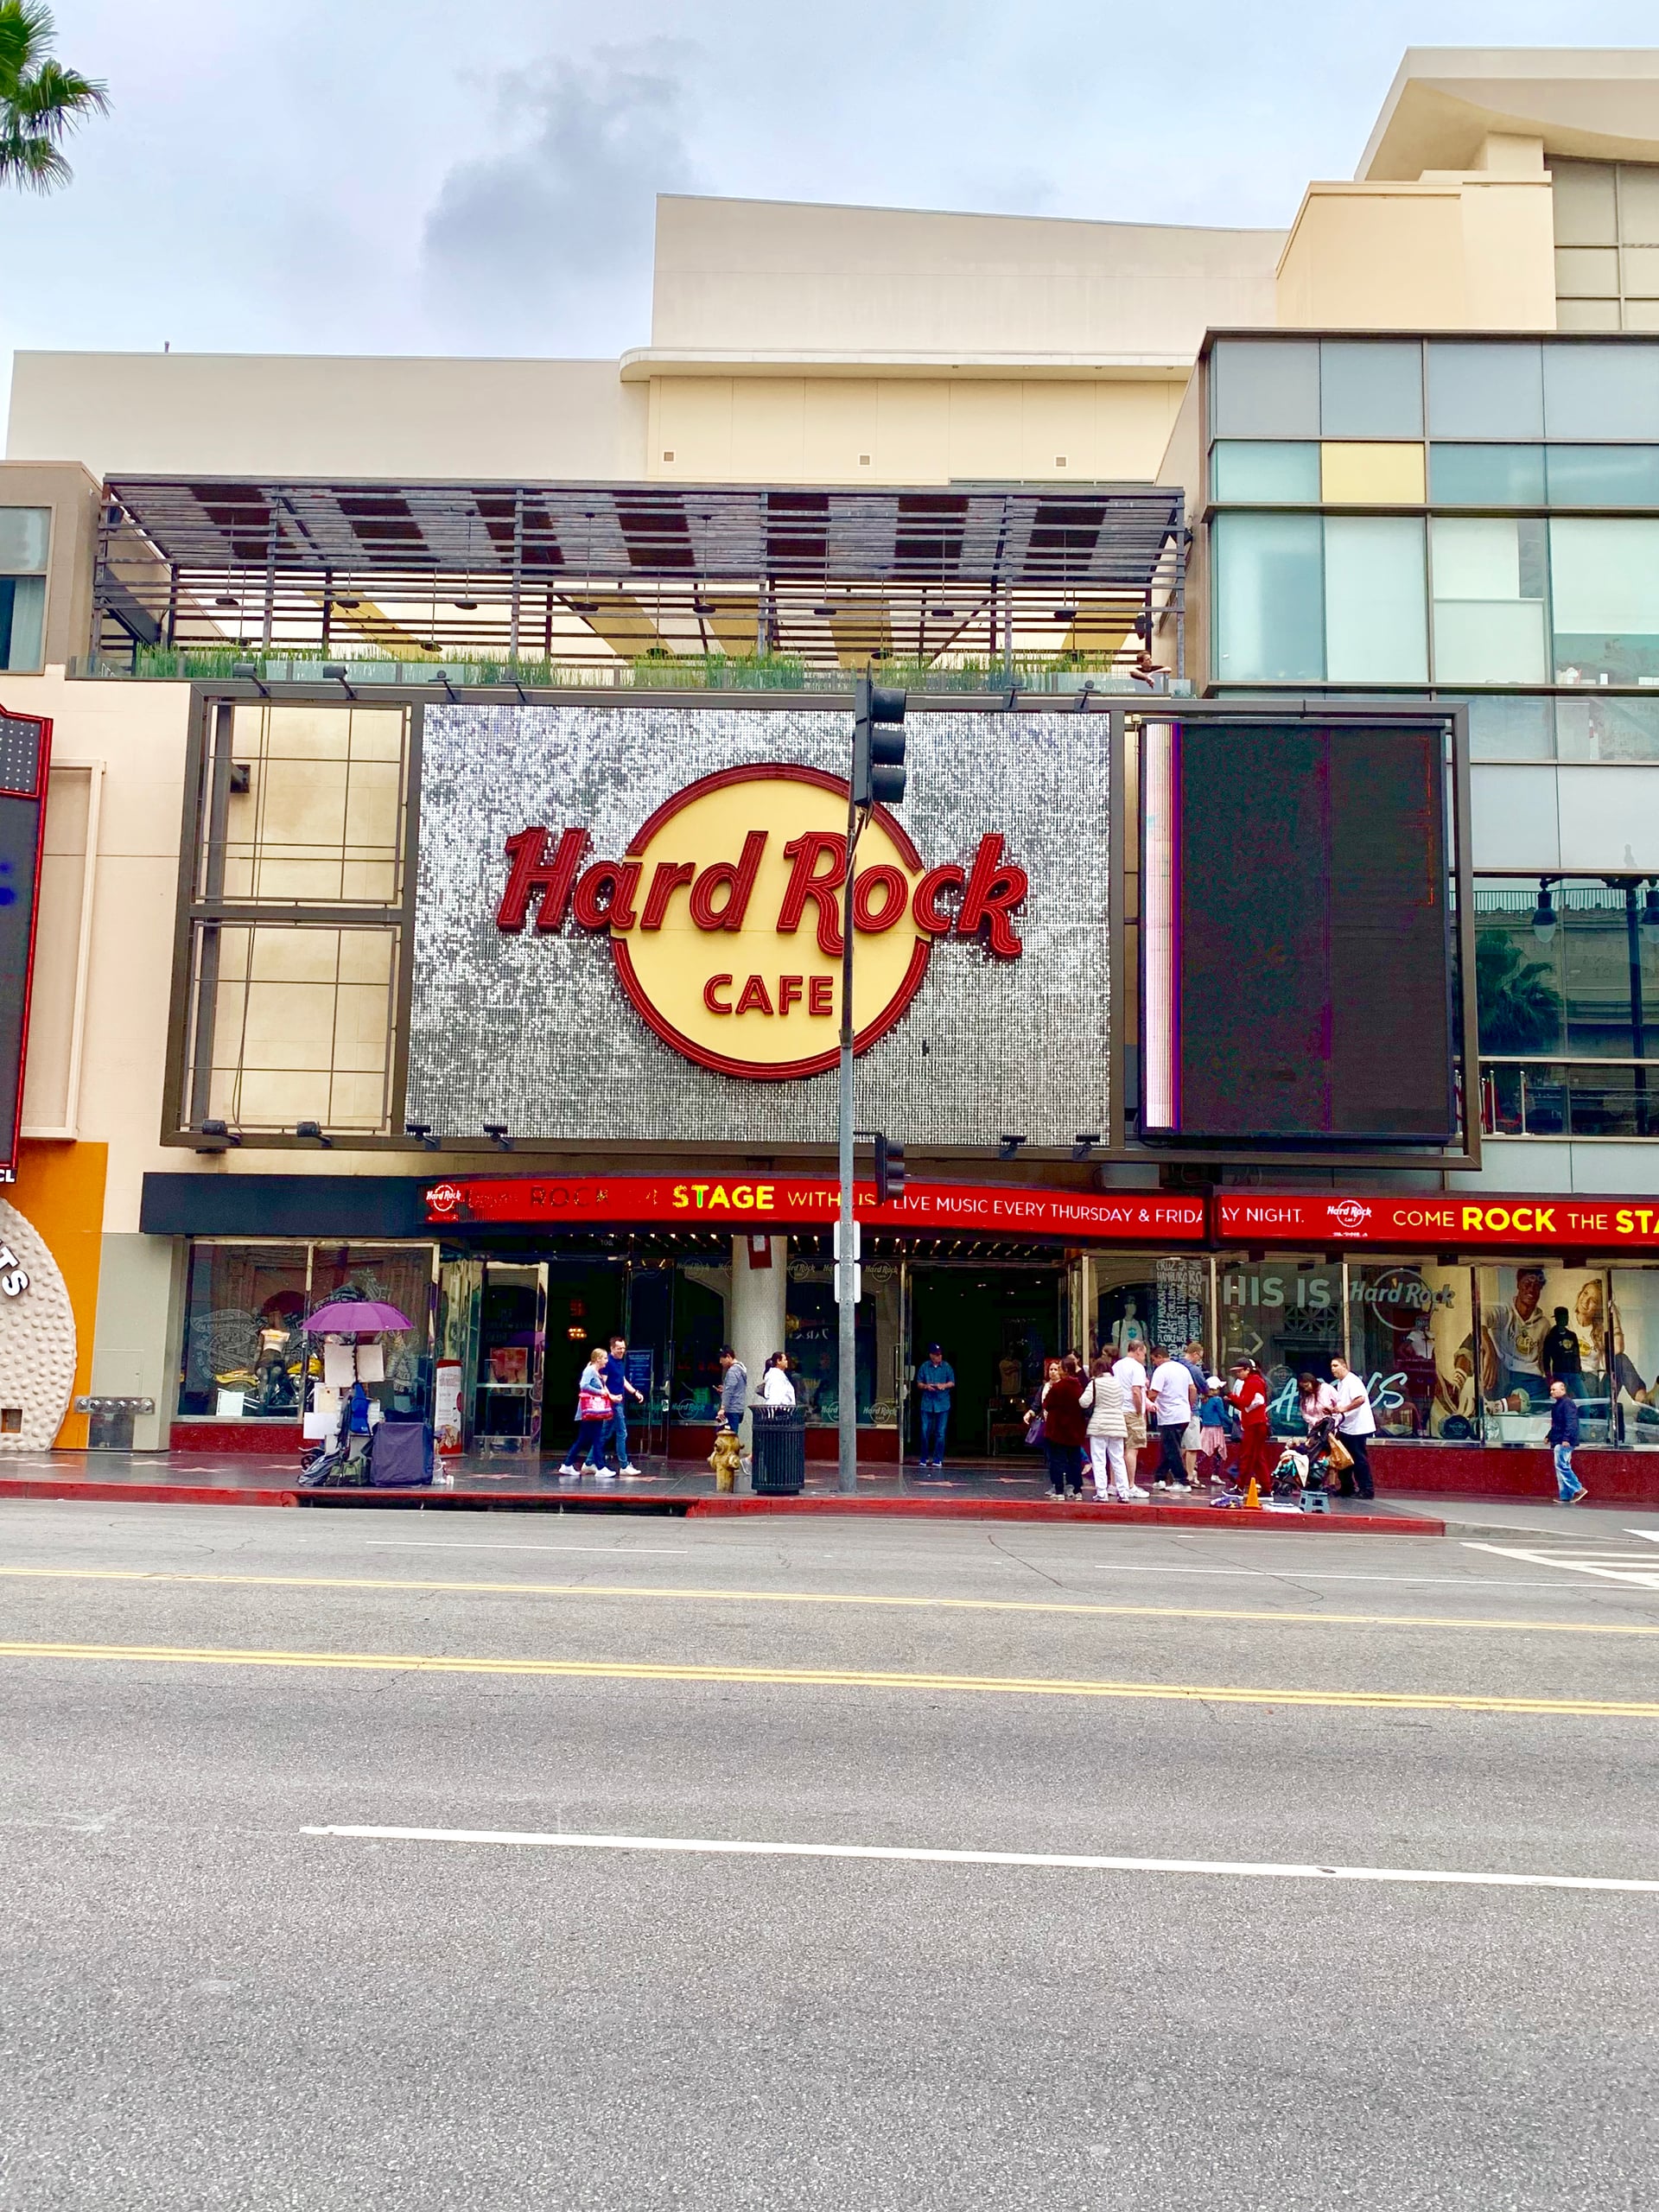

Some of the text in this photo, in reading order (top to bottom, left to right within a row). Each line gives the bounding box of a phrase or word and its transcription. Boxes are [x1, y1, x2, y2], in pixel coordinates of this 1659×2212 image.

[496, 826, 1028, 958] Hard Rock
[702, 973, 834, 1015] CAFE
[426, 1191, 444, 1200] Hard
[444, 1190, 461, 1201] Rock
[672, 1185, 775, 1210] STAGE
[787, 1191, 842, 1208] WITH
[893, 1195, 931, 1211] LIVE
[936, 1197, 988, 1213] MUSIC
[994, 1200, 1046, 1217] EVERY
[1050, 1204, 1134, 1223] THURSDAY
[1138, 1208, 1150, 1223] &
[1246, 1207, 1305, 1224] NIGHT.
[1327, 1205, 1372, 1218] Hard Rock
[1393, 1206, 1659, 1234] COME ROCK THE ST
[882, 1265, 899, 1275] Rock
[1297, 1277, 1332, 1309] IS
[1350, 1279, 1456, 1310] Hard Rock
[862, 1406, 880, 1414] Hard
